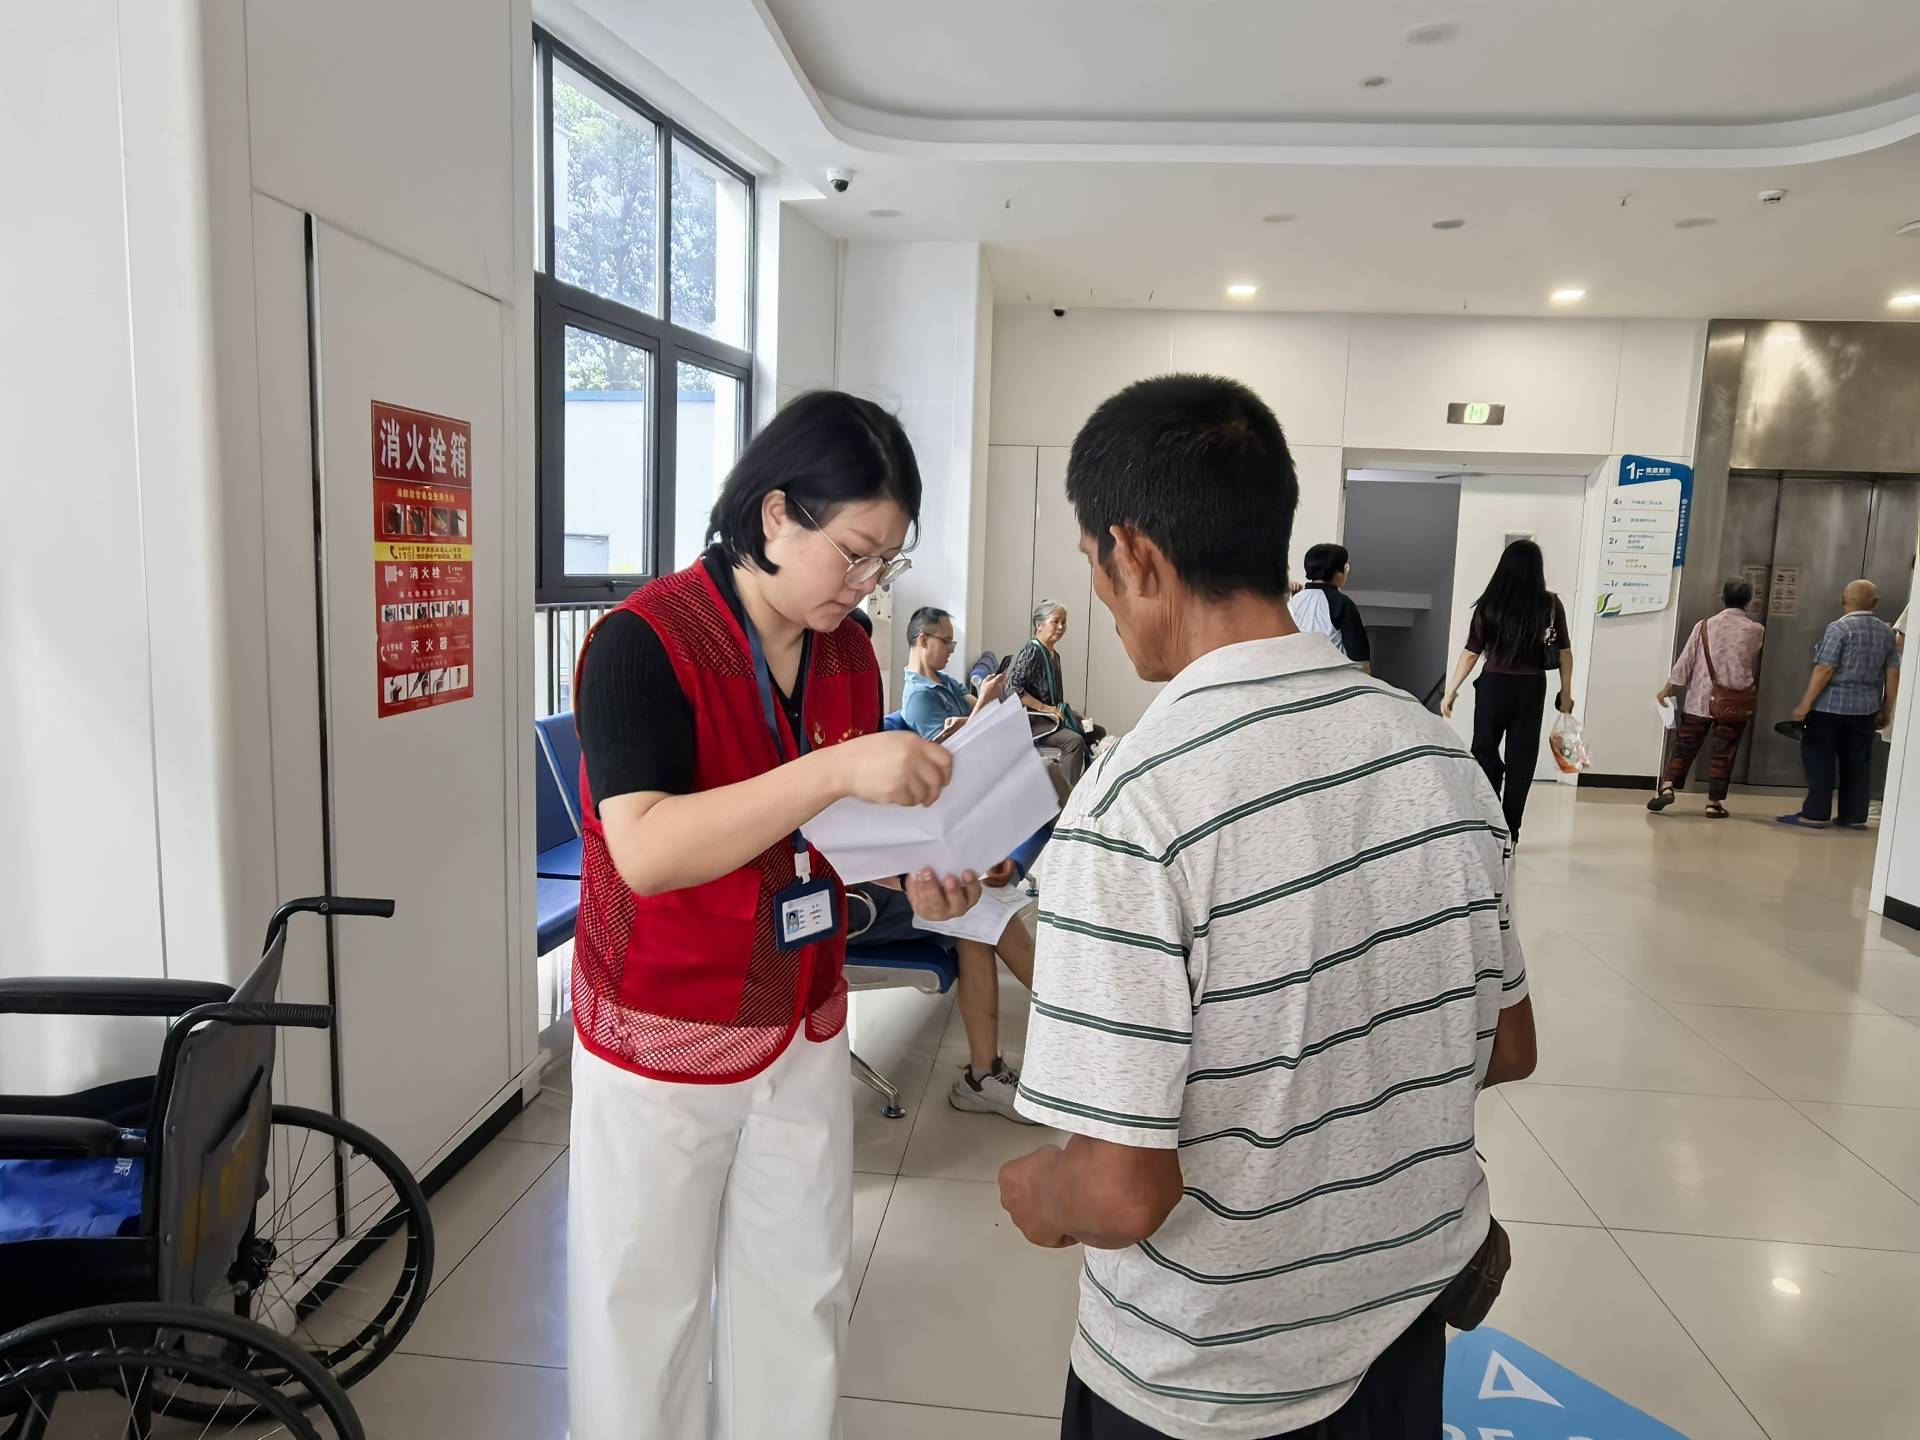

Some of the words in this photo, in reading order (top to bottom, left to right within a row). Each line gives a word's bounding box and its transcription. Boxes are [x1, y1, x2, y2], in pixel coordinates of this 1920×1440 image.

[379, 418, 467, 478] 消火栓箱
[1626, 462, 1645, 479] 1F
